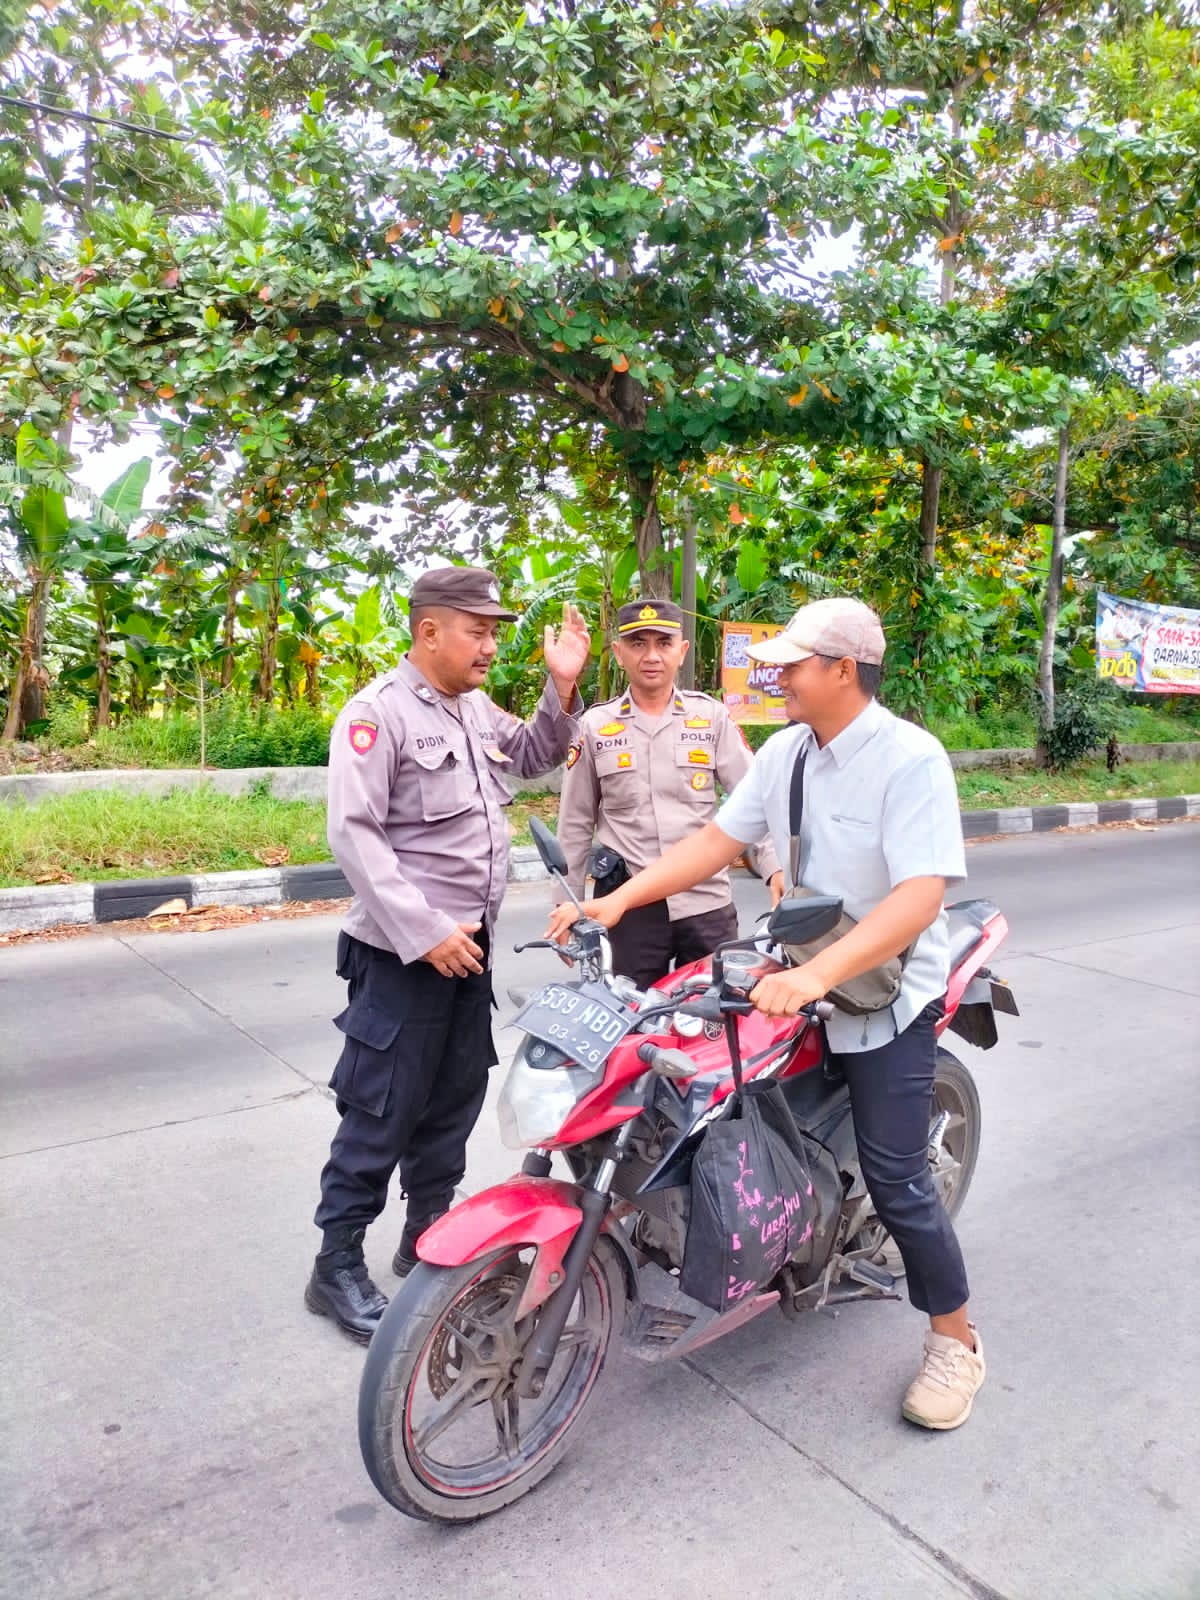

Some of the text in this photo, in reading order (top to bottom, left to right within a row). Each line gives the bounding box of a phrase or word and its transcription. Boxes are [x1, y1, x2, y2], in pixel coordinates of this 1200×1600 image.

[416, 735, 447, 750] DIDIK
[596, 738, 628, 750] DONI
[681, 732, 716, 743] POLRI
[578, 1003, 622, 1043] NBD
